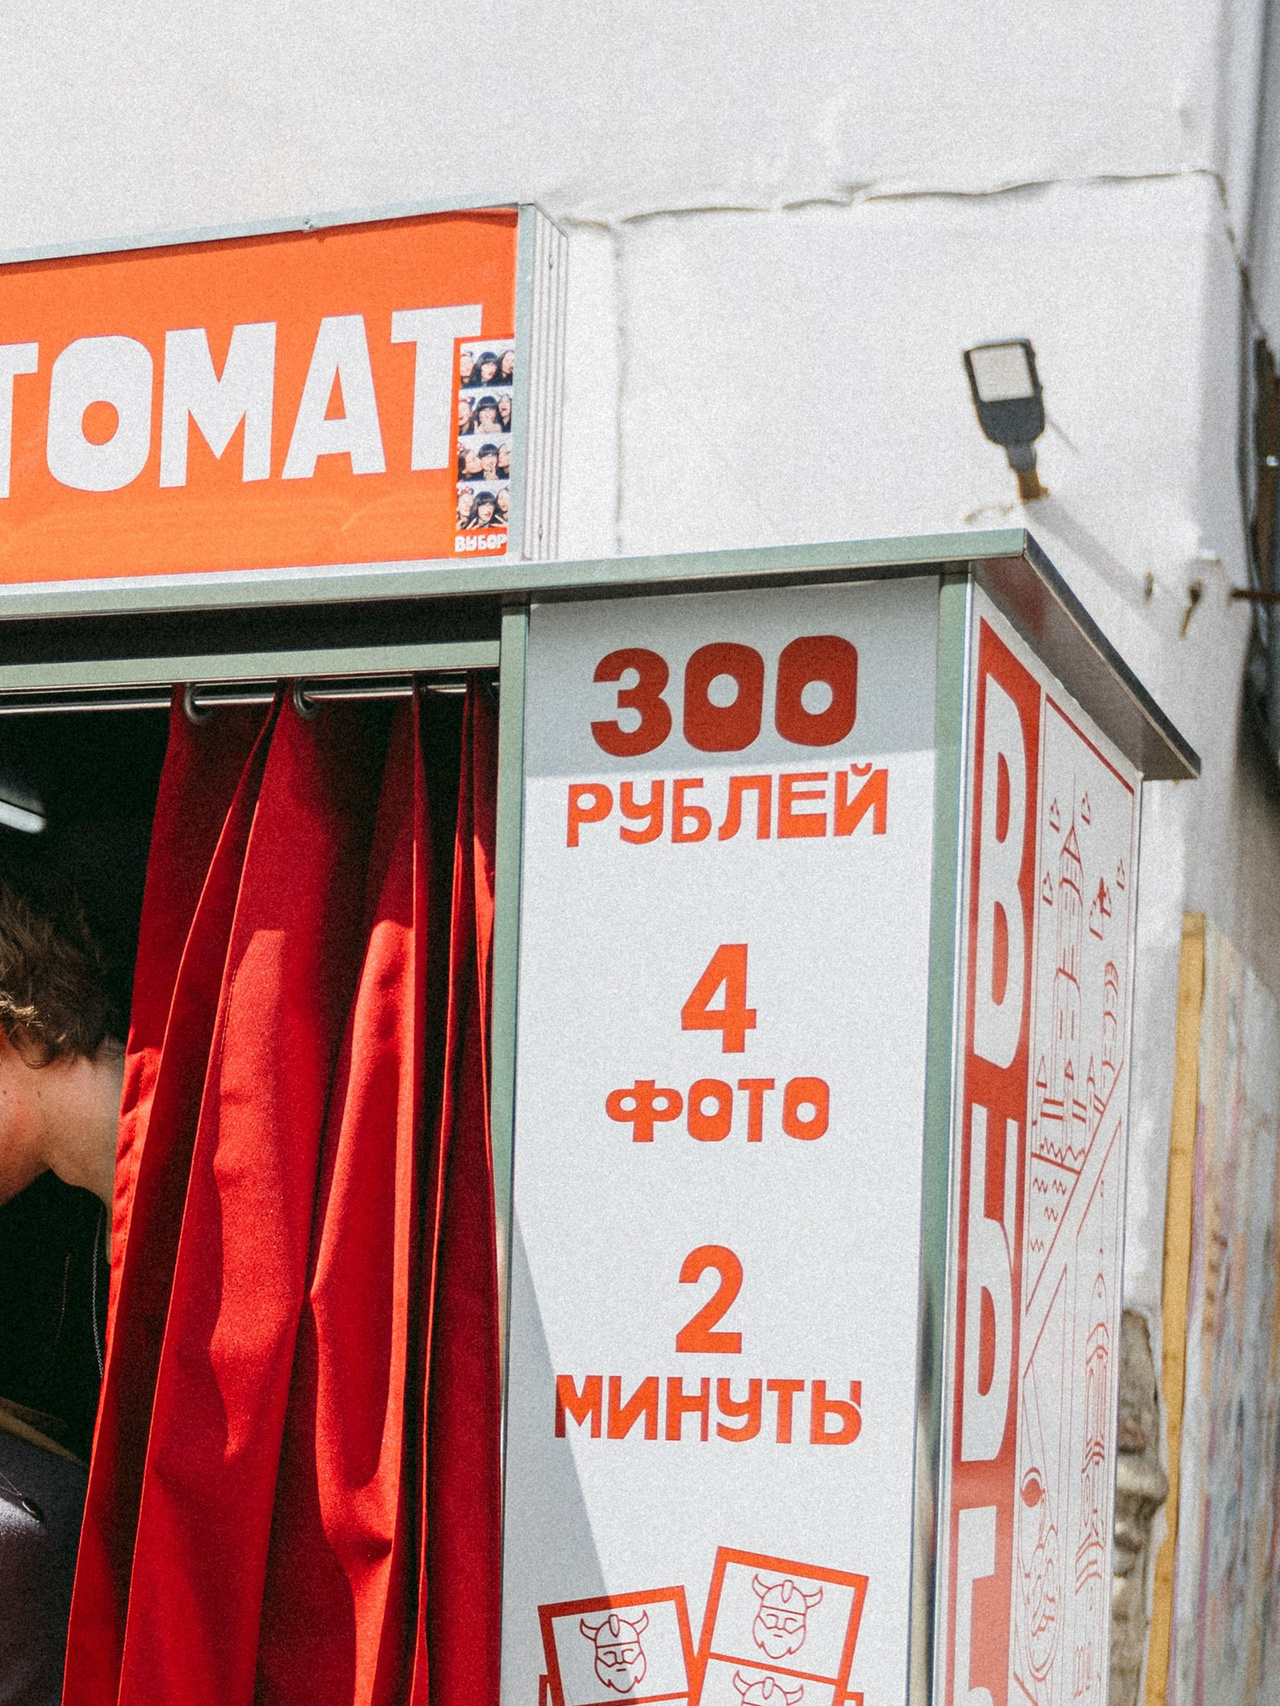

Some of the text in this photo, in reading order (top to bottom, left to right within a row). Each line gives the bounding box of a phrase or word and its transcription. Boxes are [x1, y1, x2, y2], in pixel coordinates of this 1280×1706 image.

[590, 635, 859, 758] 300
[565, 763, 889, 847] РУБЛЕЙ
[680, 943, 757, 1054] 4
[605, 1076, 831, 1143] ФОТО
[675, 1244, 744, 1355] 2
[555, 1374, 862, 1446] МИНУТЫ
